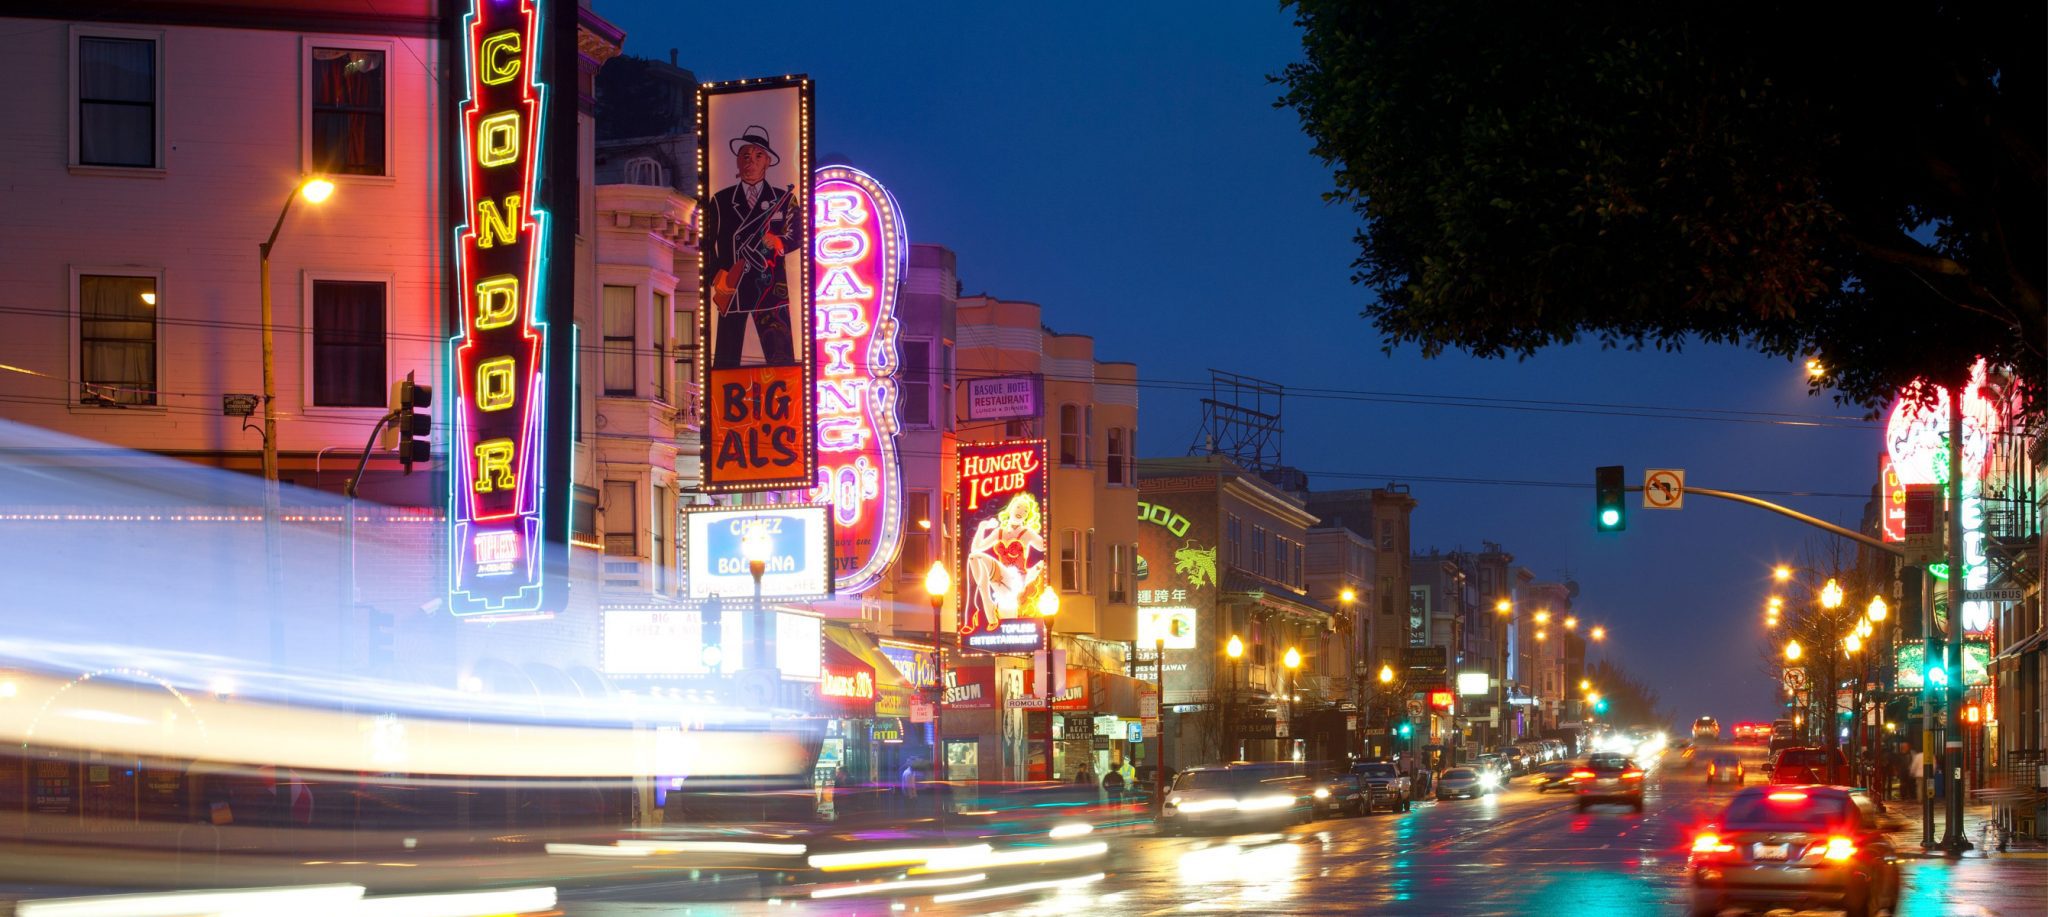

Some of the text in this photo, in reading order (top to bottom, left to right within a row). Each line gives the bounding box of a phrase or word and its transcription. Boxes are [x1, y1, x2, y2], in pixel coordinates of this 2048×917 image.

[475, 30, 522, 493] CONDOR
[815, 191, 873, 452] ROARING
[974, 382, 1029, 396] BASQUE HOTEL
[723, 380, 792, 423] BIG
[975, 394, 1029, 407] RESTAURANT
[716, 424, 799, 470] AL'S
[963, 450, 1039, 477] HUNGRY
[981, 472, 1025, 497] CLUB
[1966, 590, 2022, 600] COLUMBUS
[1000, 623, 1036, 634] TOPLESS
[969, 634, 1039, 646] ENTERTAINMENT
[873, 730, 898, 739] ATM
[1065, 732, 1093, 740] MUSEUM
